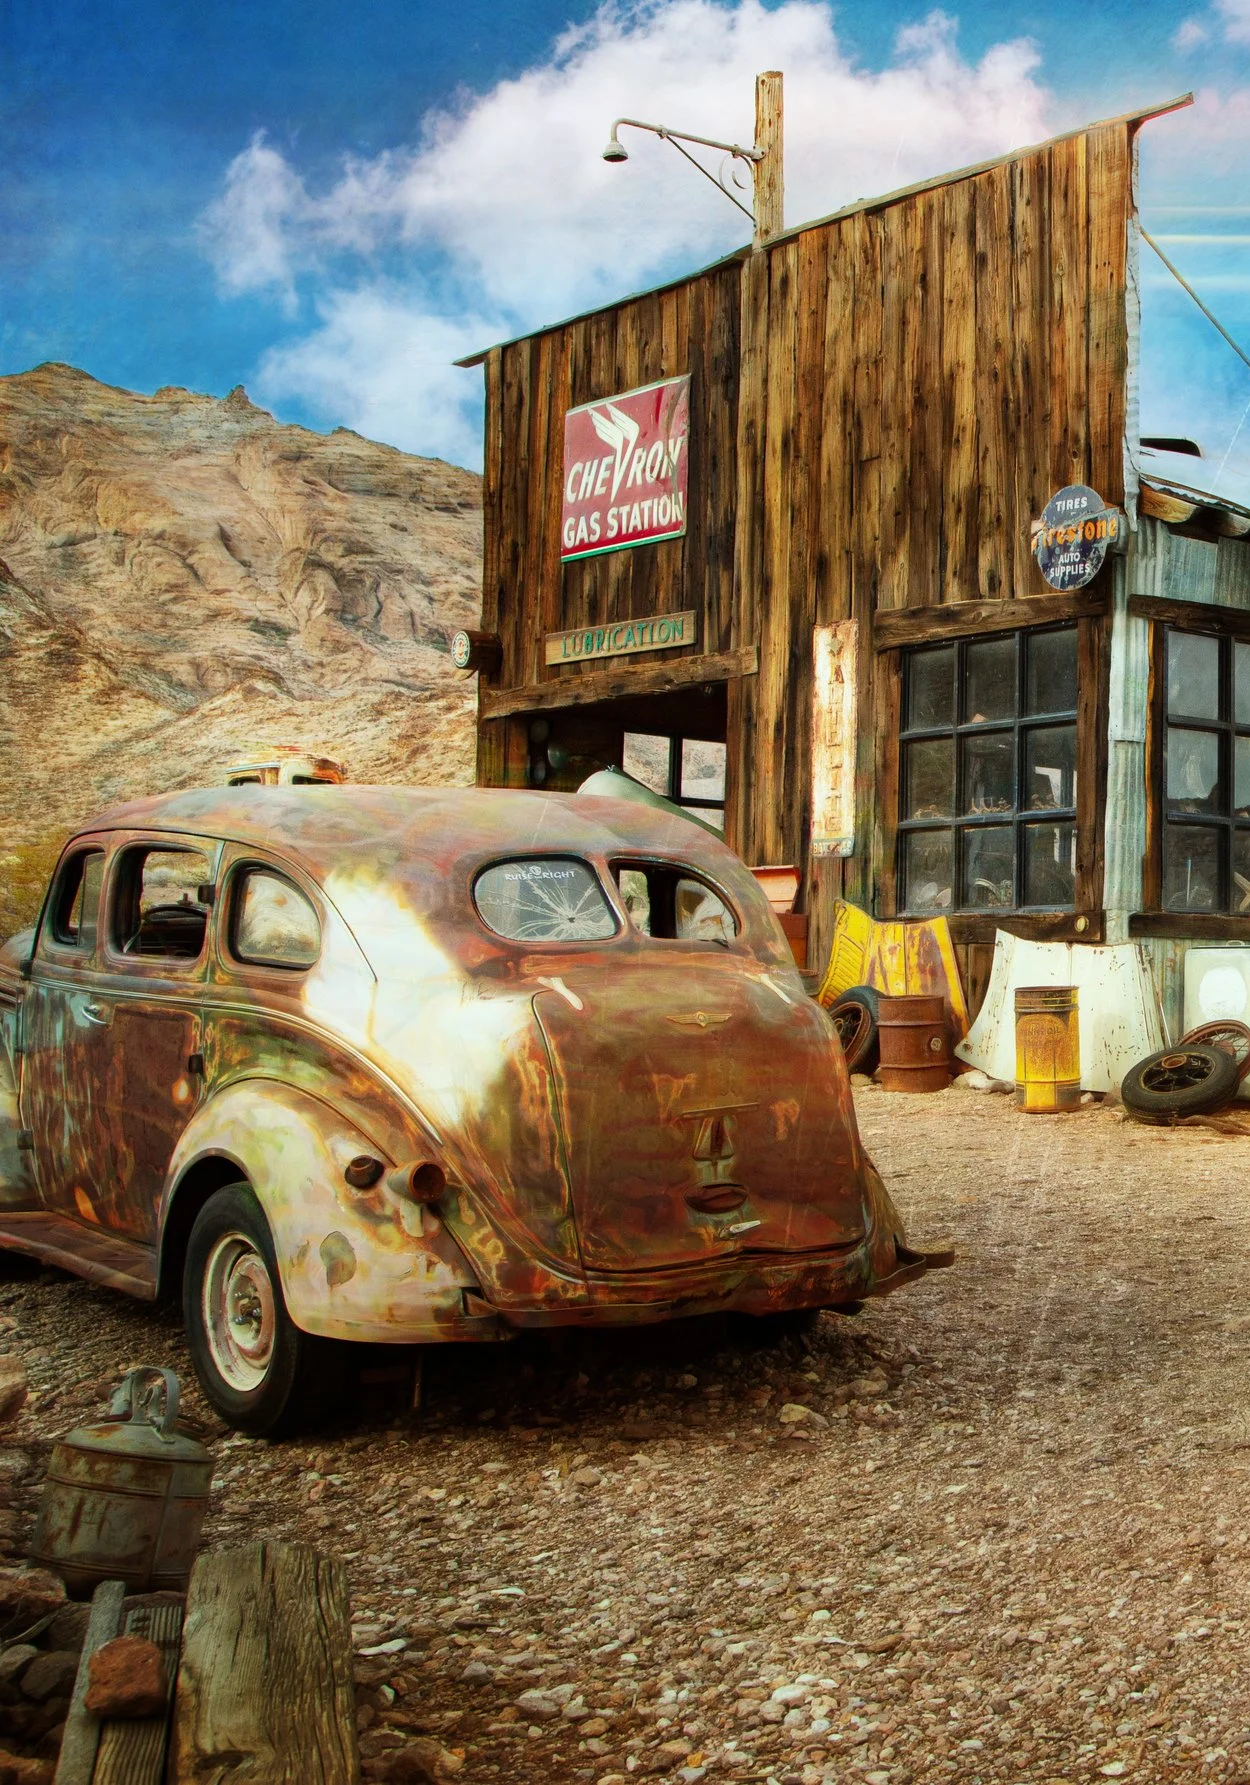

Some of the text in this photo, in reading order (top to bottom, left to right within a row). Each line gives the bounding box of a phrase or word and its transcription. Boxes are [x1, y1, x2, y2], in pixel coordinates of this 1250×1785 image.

[565, 434, 687, 504] CHEVRON
[1055, 496, 1088, 512] TIRES
[563, 491, 684, 548] GAS STATION
[1049, 563, 1091, 578] SUPPLIES
[1058, 551, 1081, 565] AUTO
[561, 617, 684, 658] LUBRICATION
